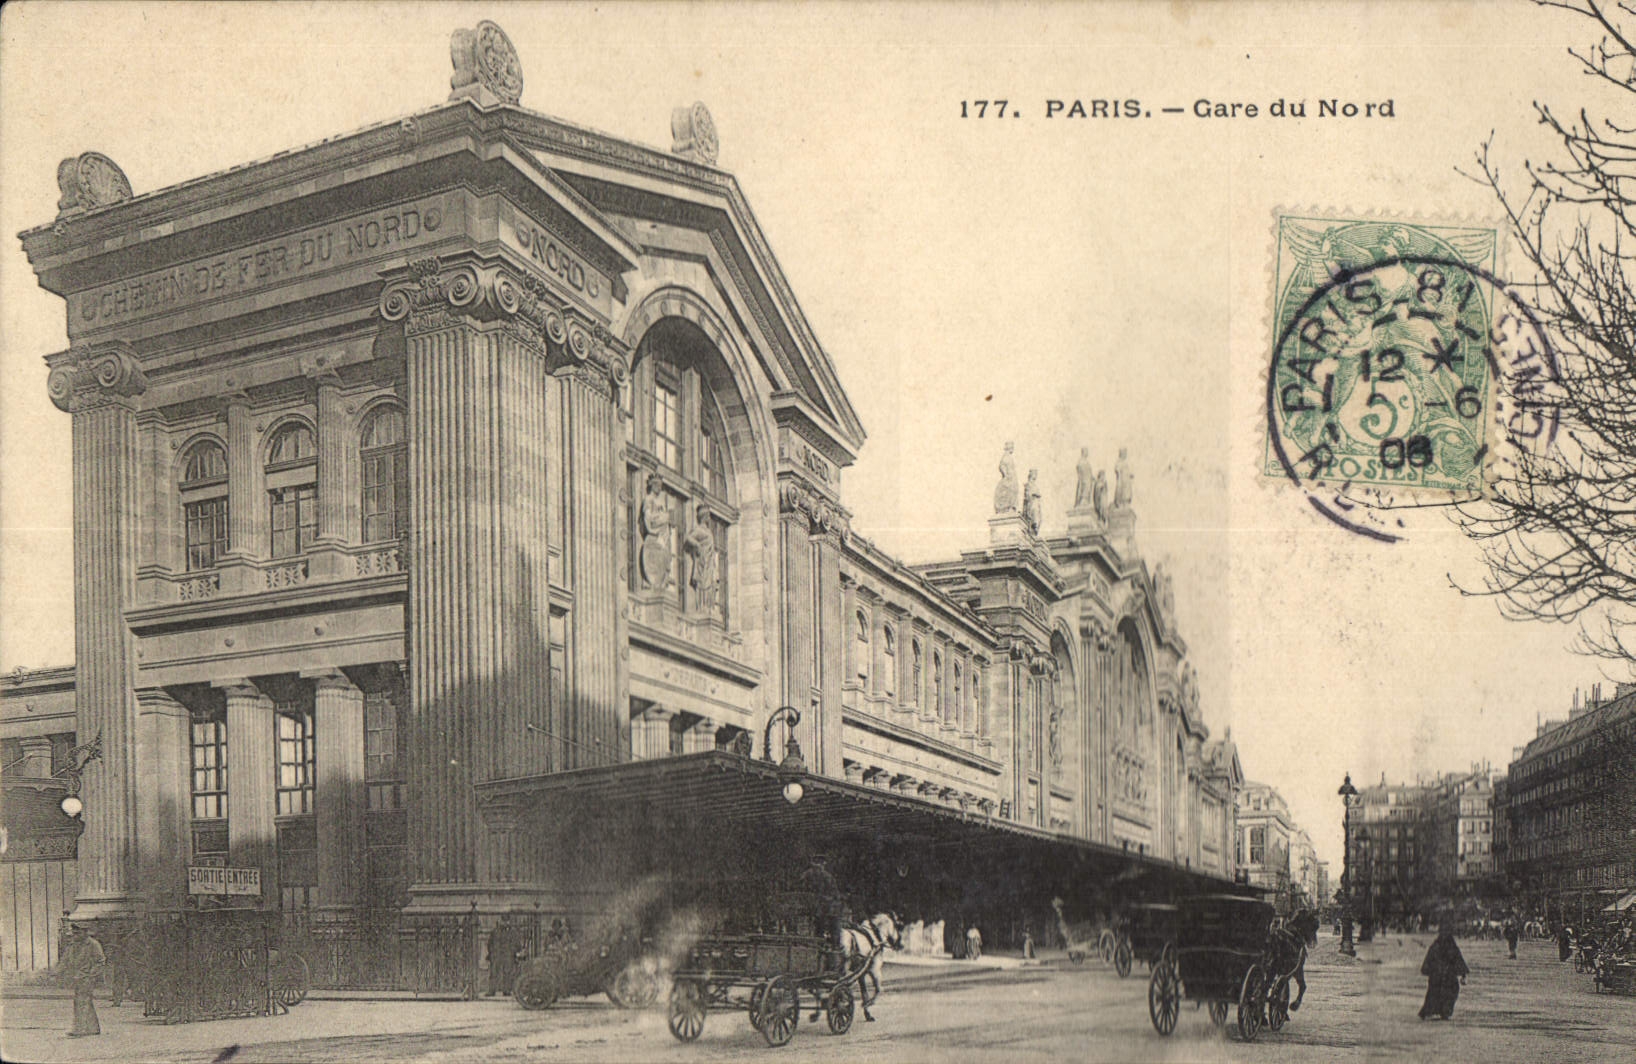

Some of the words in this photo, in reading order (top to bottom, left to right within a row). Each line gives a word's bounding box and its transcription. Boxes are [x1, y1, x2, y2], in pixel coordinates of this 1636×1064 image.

[195, 261, 226, 293] DE
[237, 246, 288, 285] FER
[301, 232, 334, 267] DU
[346, 210, 420, 254] NORD
[530, 227, 586, 292] NORD
[1323, 452, 1428, 481] POSTES
[190, 868, 224, 883] SORTIE
